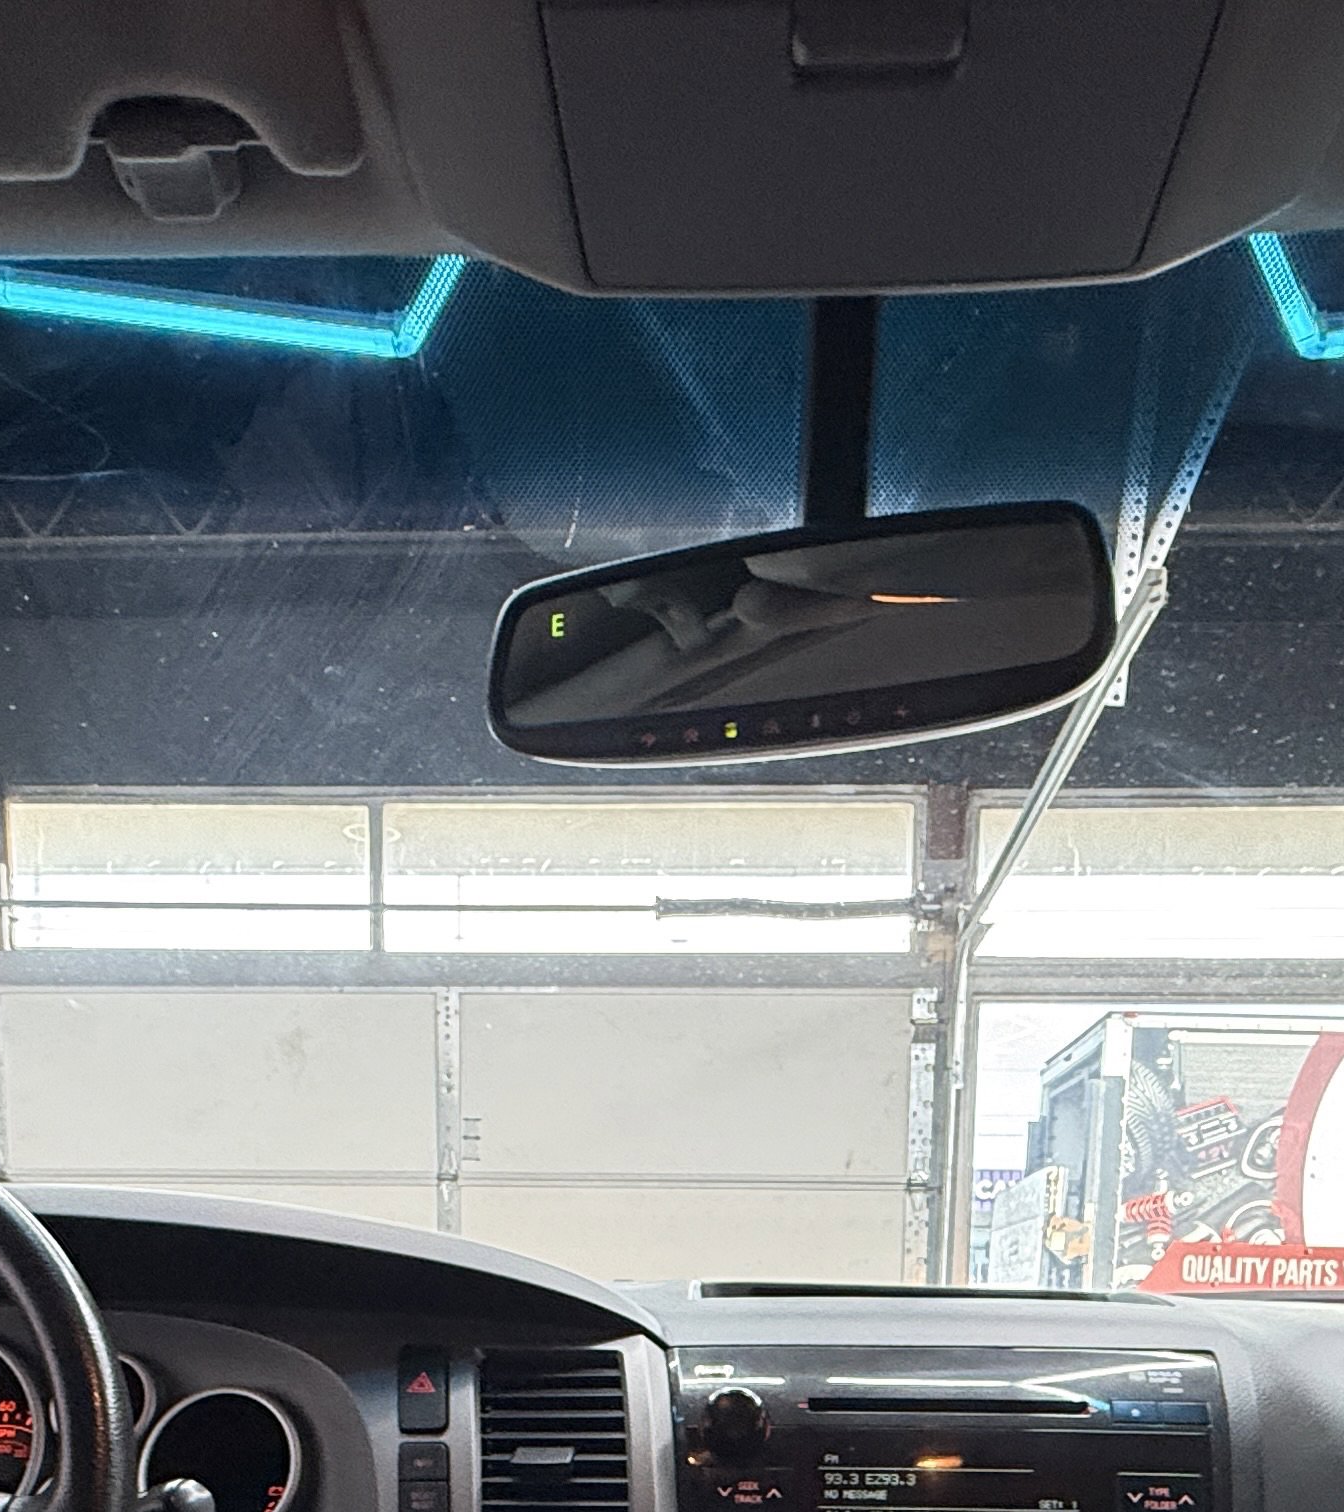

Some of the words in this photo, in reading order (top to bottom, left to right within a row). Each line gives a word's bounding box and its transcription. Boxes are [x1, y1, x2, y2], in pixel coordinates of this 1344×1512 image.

[551, 613, 565, 637] E
[976, 1179, 1017, 1199] CA
[1182, 1254, 1270, 1284] QUALITY
[1271, 1258, 1339, 1290] PARTS
[823, 1473, 860, 1486] 93.3
[864, 1473, 917, 1488] EZ93.3
[734, 1493, 764, 1505] TRACK
[823, 1489, 840, 1500] NO
[842, 1489, 889, 1501] MESSAGE
[1148, 1487, 1171, 1498] TYPE
[1143, 1499, 1178, 1511] FOLDER
